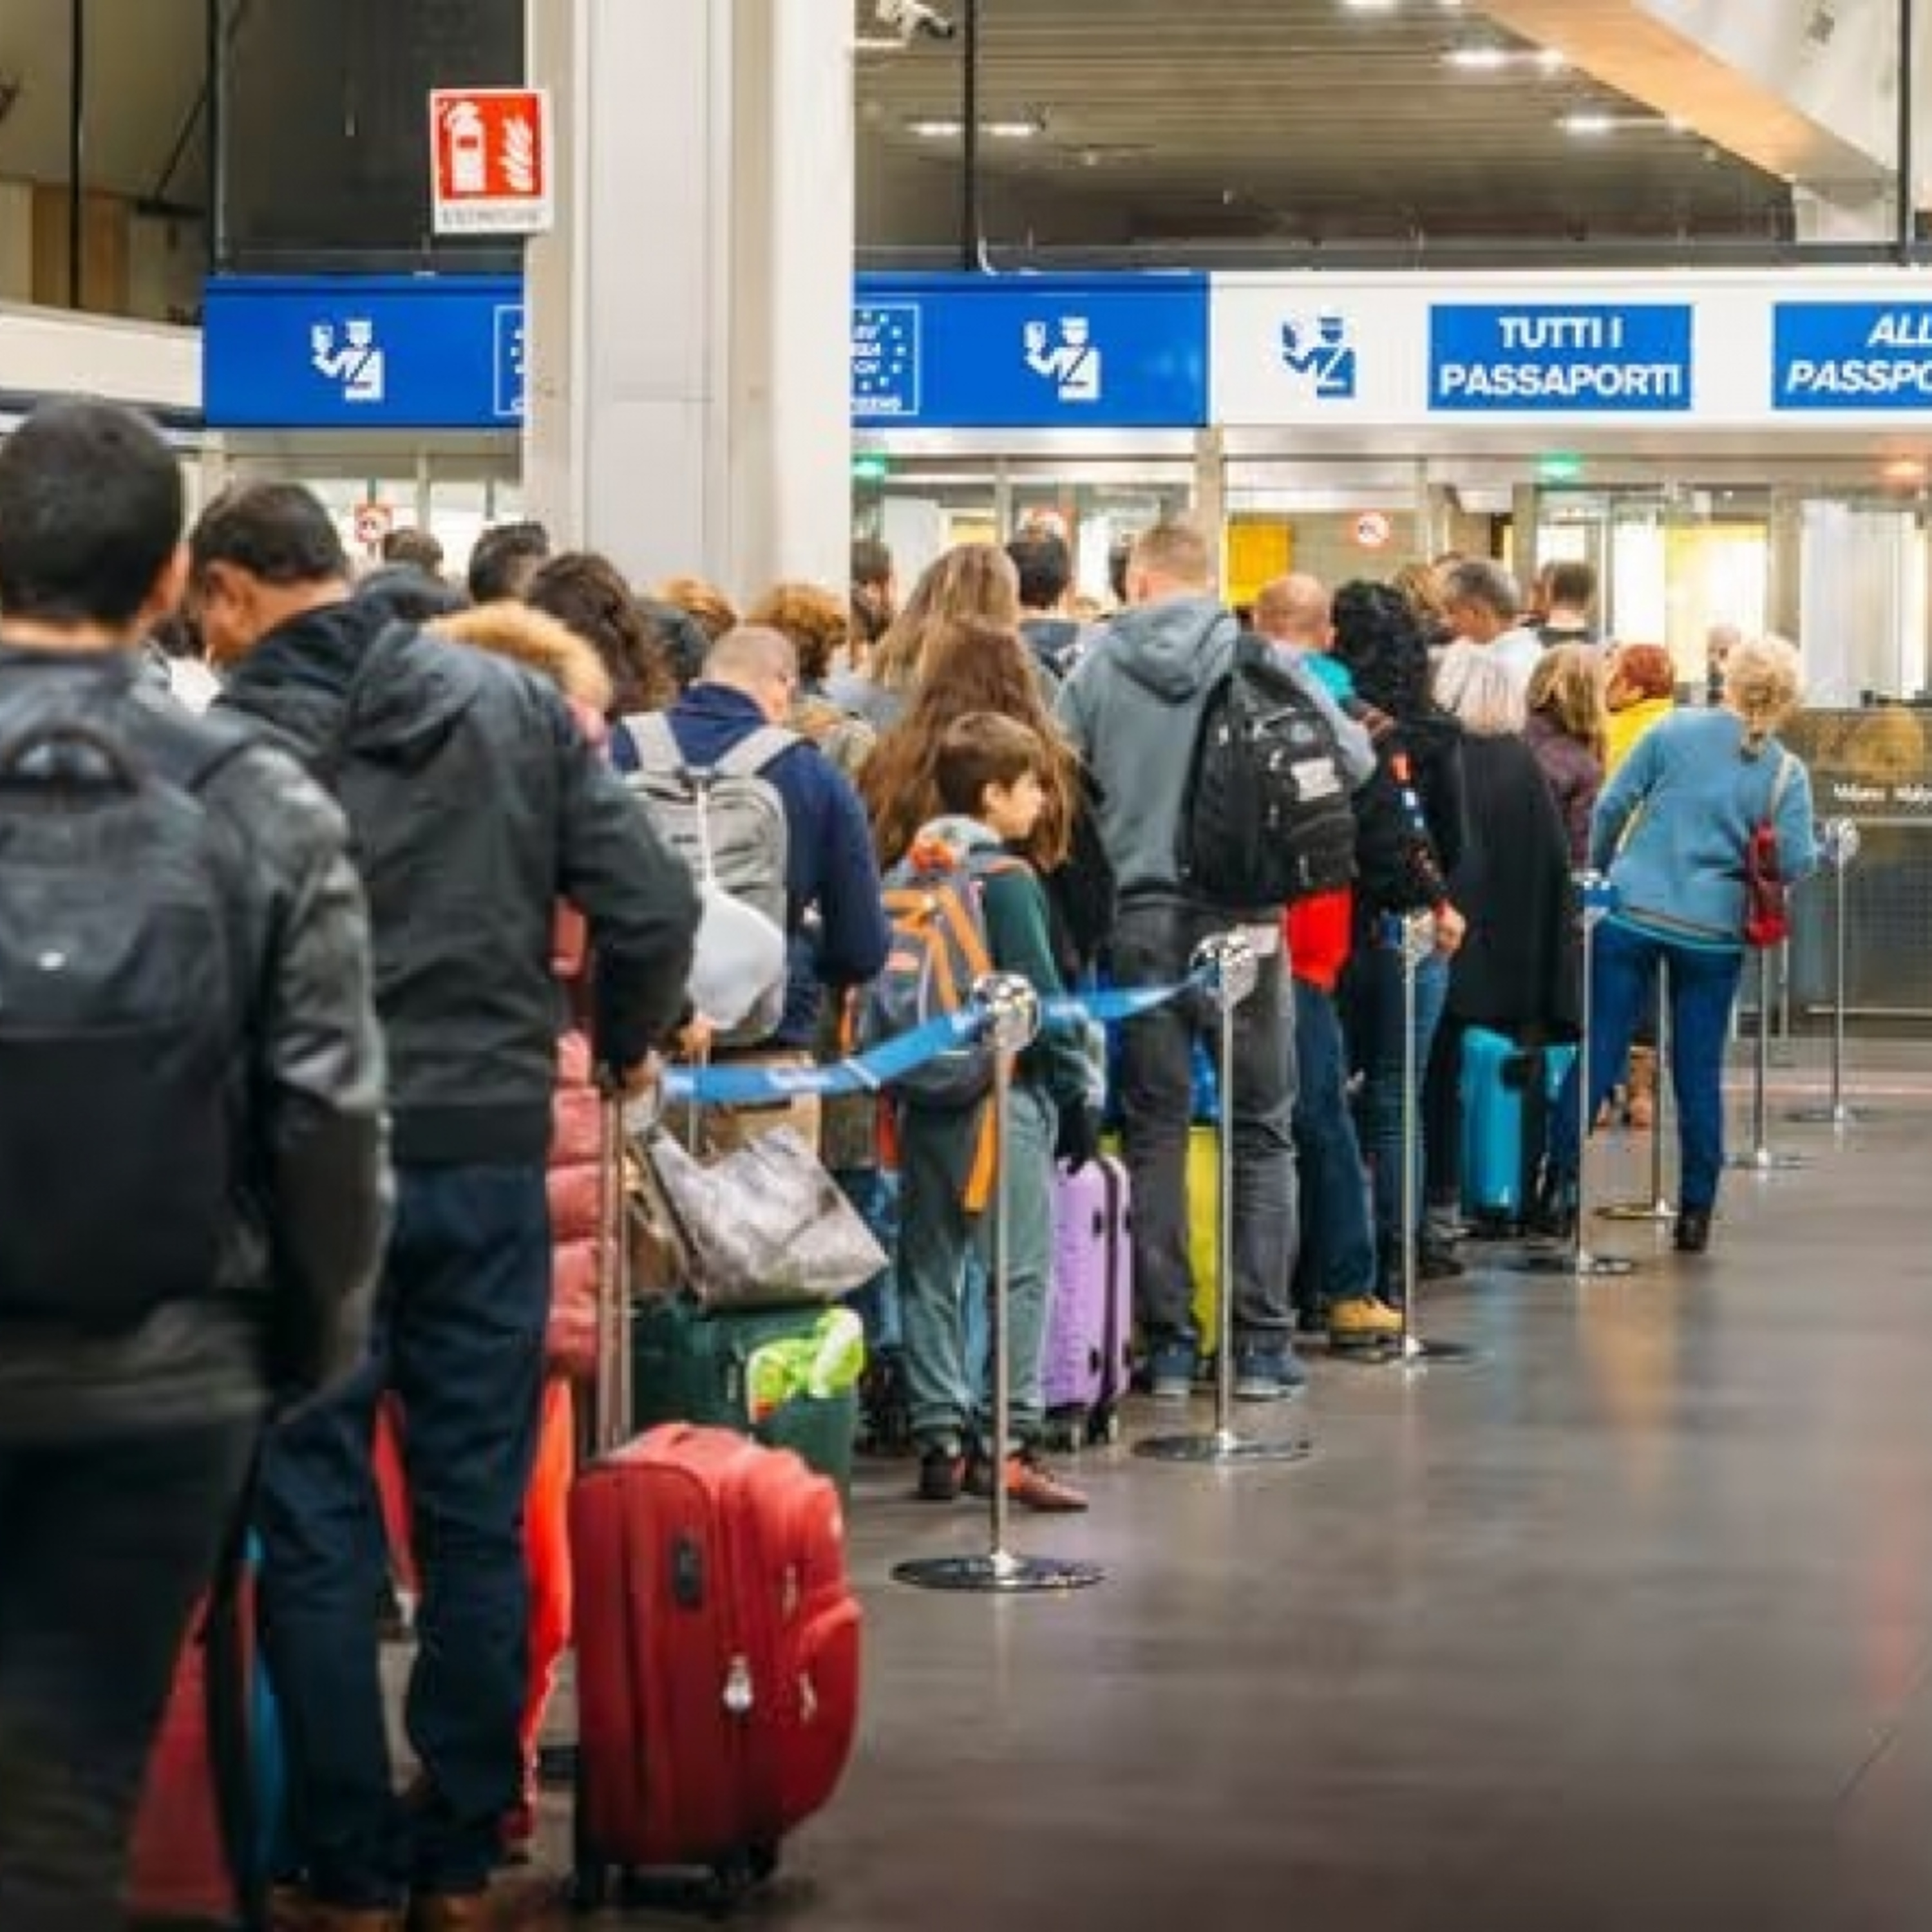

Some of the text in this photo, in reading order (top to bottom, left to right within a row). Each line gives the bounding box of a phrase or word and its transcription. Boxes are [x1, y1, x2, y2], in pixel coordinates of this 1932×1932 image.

[1499, 317, 1623, 348] TUTTI I
[1867, 314, 1932, 346] ALL
[1440, 365, 1680, 396] PASSAPORTI
